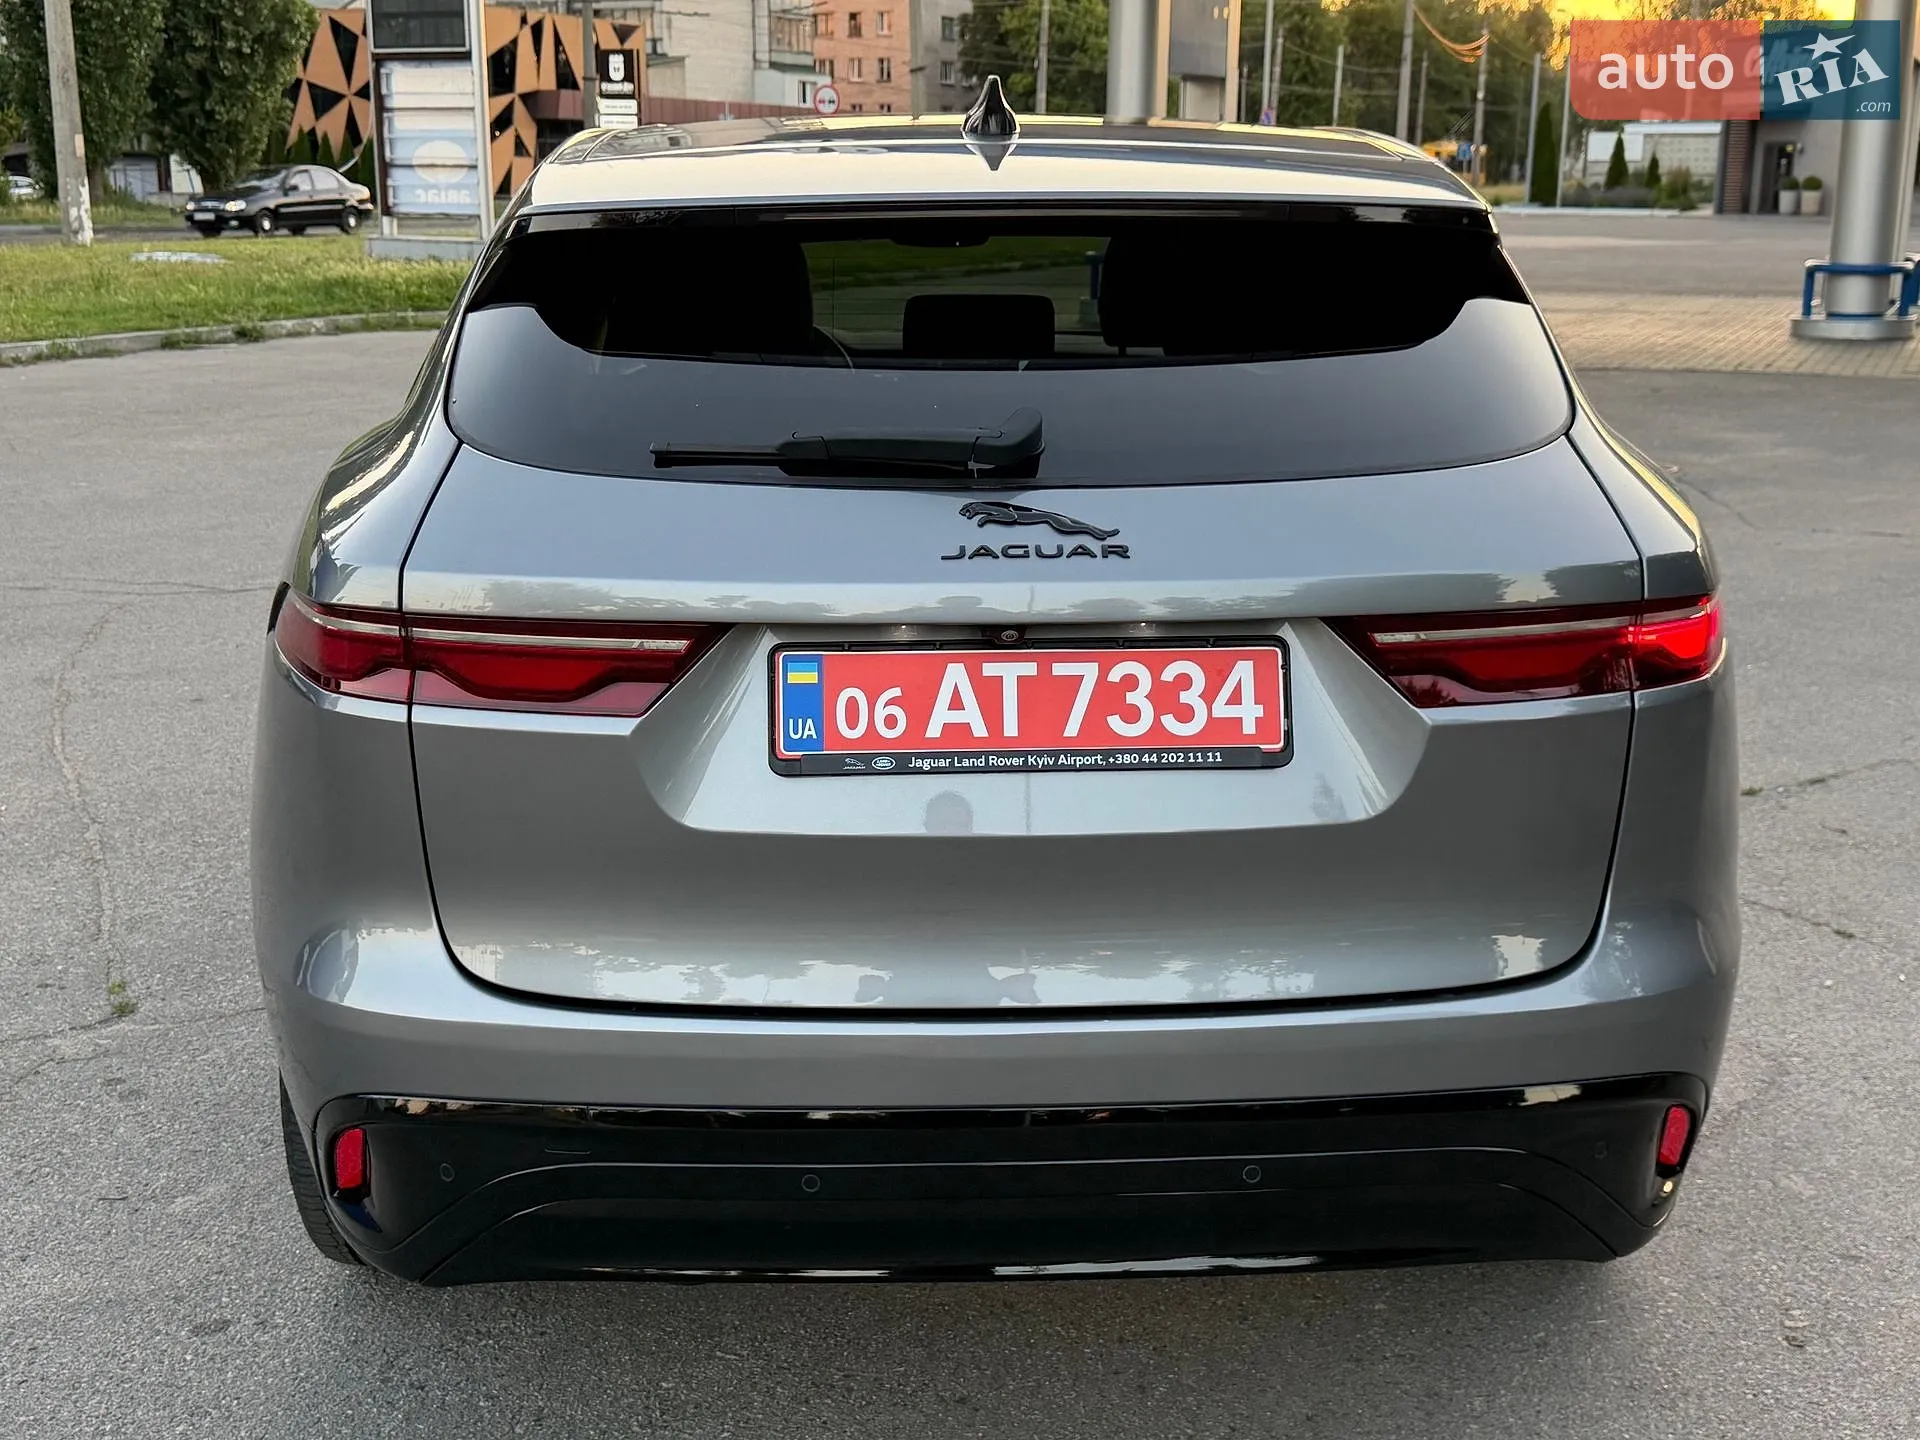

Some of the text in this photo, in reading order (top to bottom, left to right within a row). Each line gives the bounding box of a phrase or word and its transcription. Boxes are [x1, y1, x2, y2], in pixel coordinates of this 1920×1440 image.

[940, 543, 1131, 561] JAGUAR
[835, 660, 1264, 740] 06 AT 7334
[788, 717, 818, 741] UA
[908, 751, 1223, 771] Jaguar Land Rover Kyiv Airport, +380 44 202 11 11
